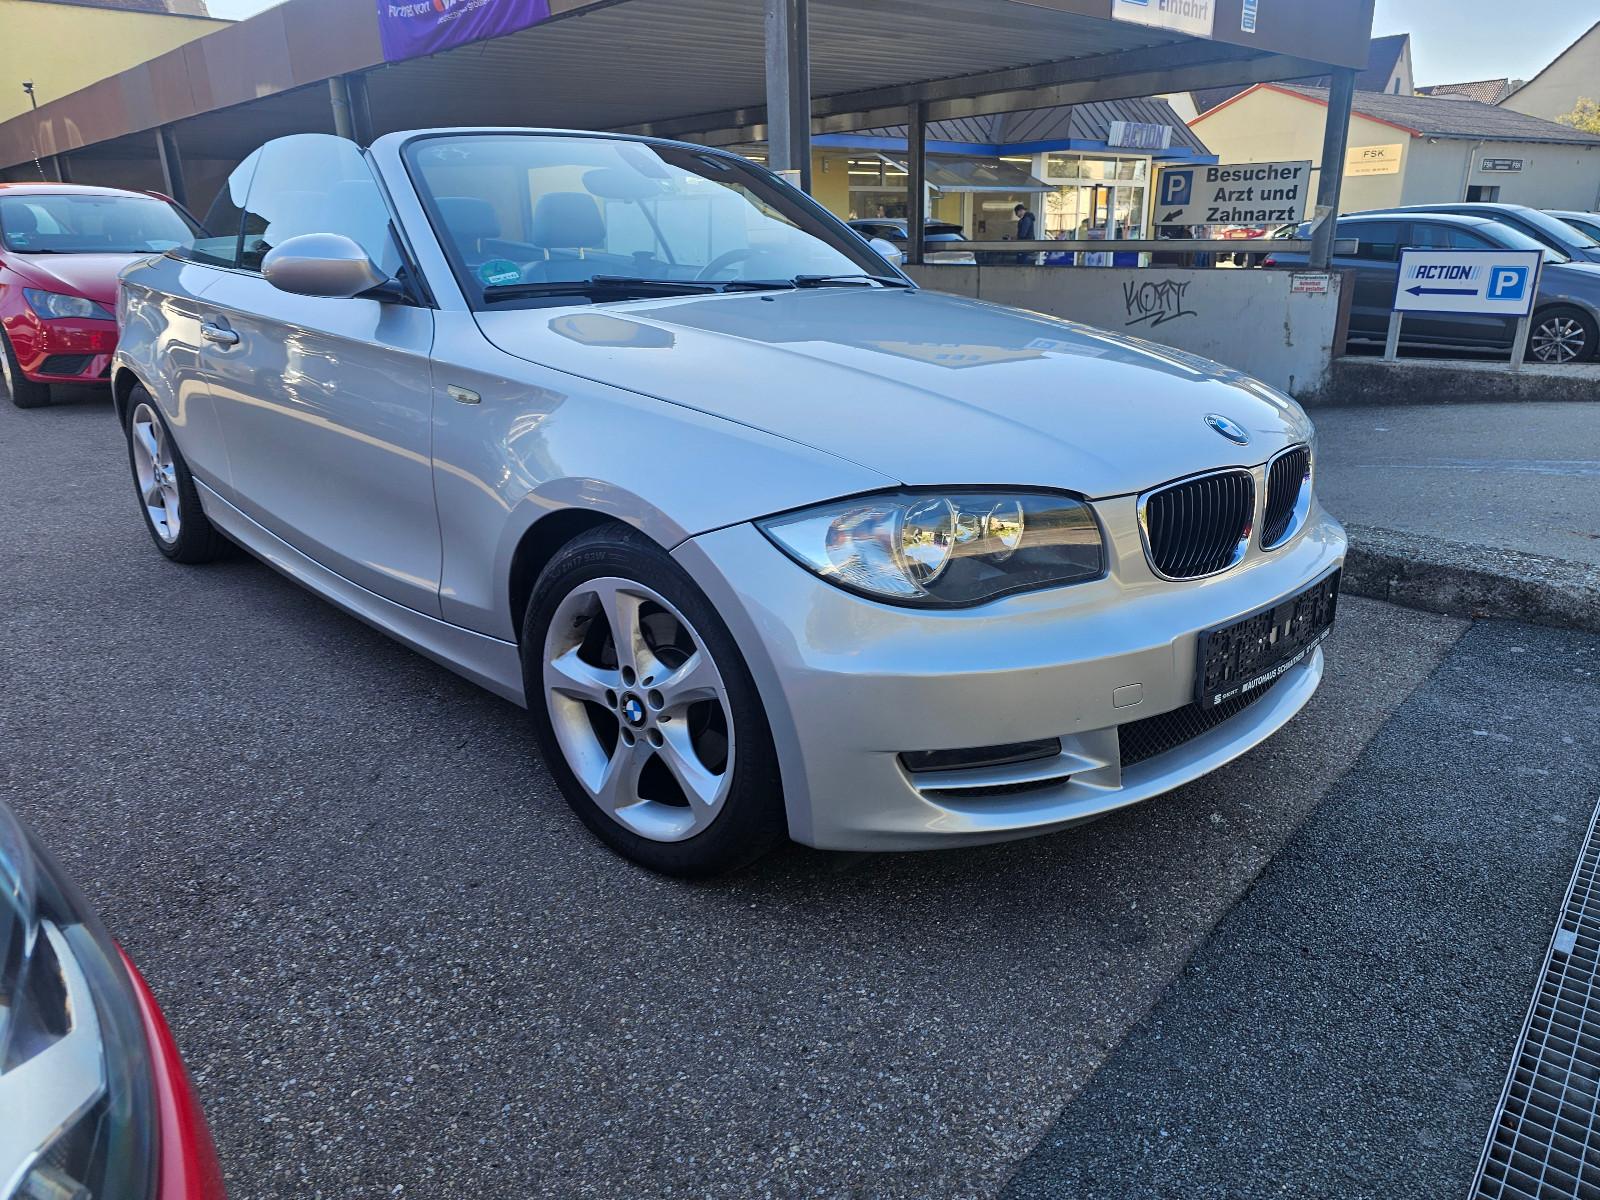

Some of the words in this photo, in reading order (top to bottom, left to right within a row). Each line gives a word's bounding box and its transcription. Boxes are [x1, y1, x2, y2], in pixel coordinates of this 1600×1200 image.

[1121, 122, 1164, 148] ACTION
[1363, 149, 1385, 158] FSK
[1206, 164, 1302, 183] Besucher
[1167, 175, 1186, 202] P
[1213, 187, 1254, 202] Arzt
[1260, 184, 1299, 201] und
[1206, 206, 1295, 222] Zahnarzt
[1415, 265, 1473, 280] ACTION
[1495, 271, 1519, 296] P
[1248, 669, 1277, 690] AUTOHAUS
